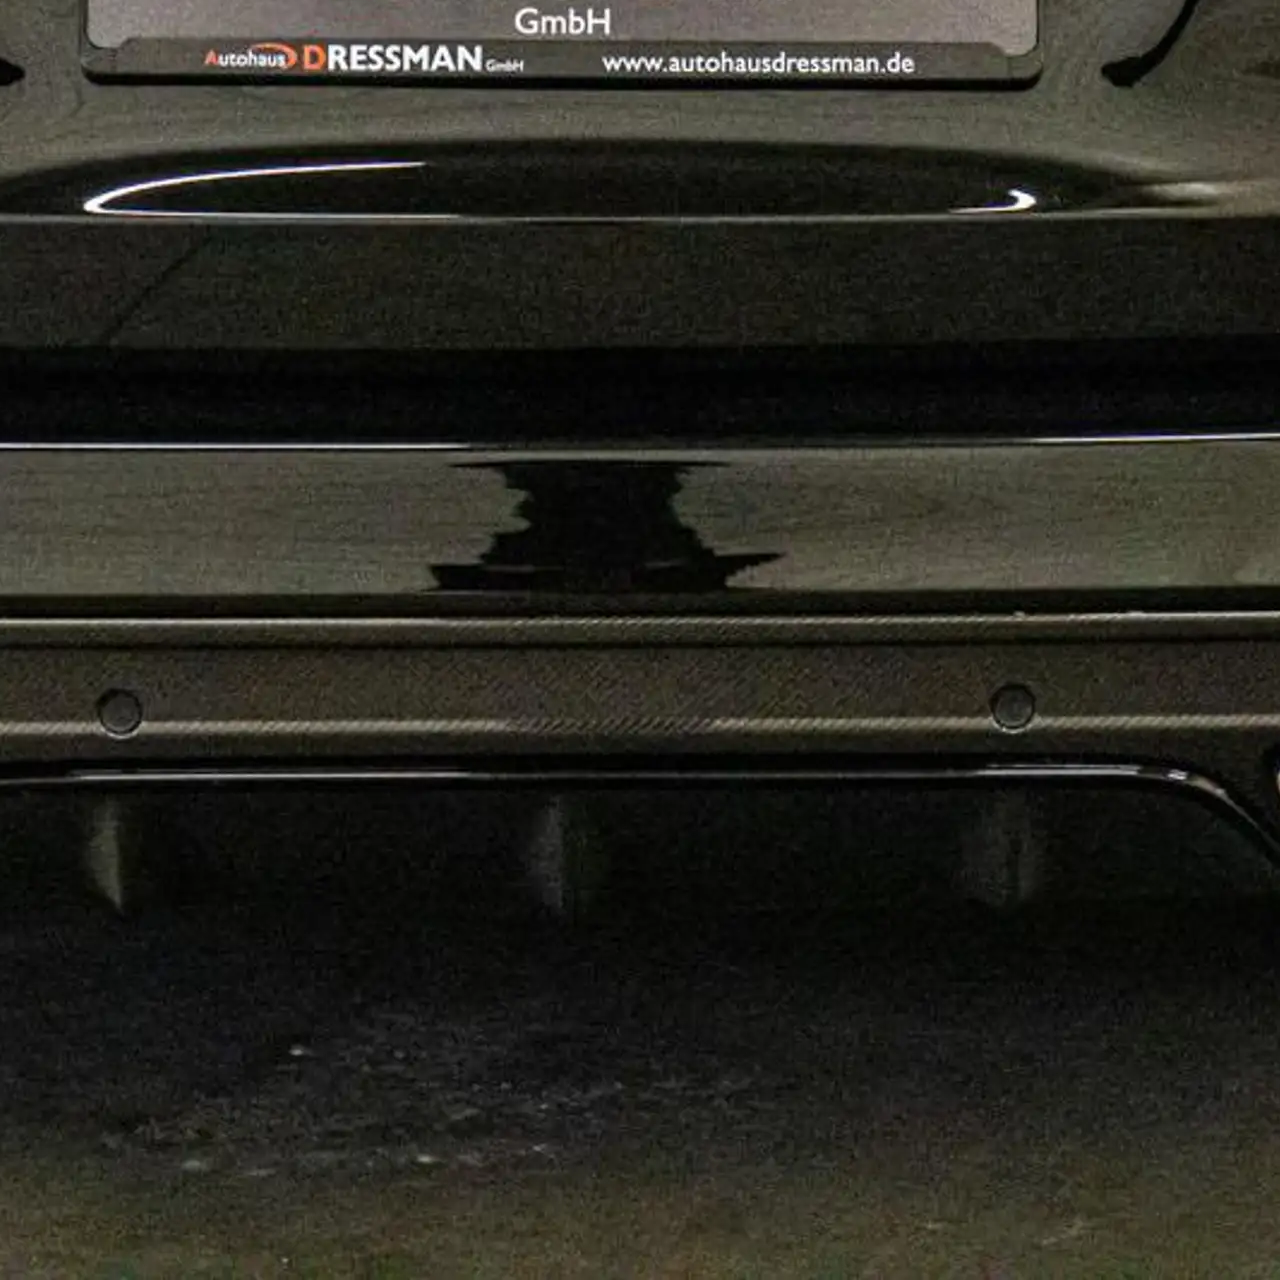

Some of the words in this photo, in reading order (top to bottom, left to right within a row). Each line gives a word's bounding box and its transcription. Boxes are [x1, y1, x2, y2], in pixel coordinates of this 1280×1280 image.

[514, 7, 612, 36] GmbH
[205, 49, 287, 69] Autohaus
[304, 45, 484, 72] DRESSMAN
[602, 51, 915, 74] www.autohausdressman.de
